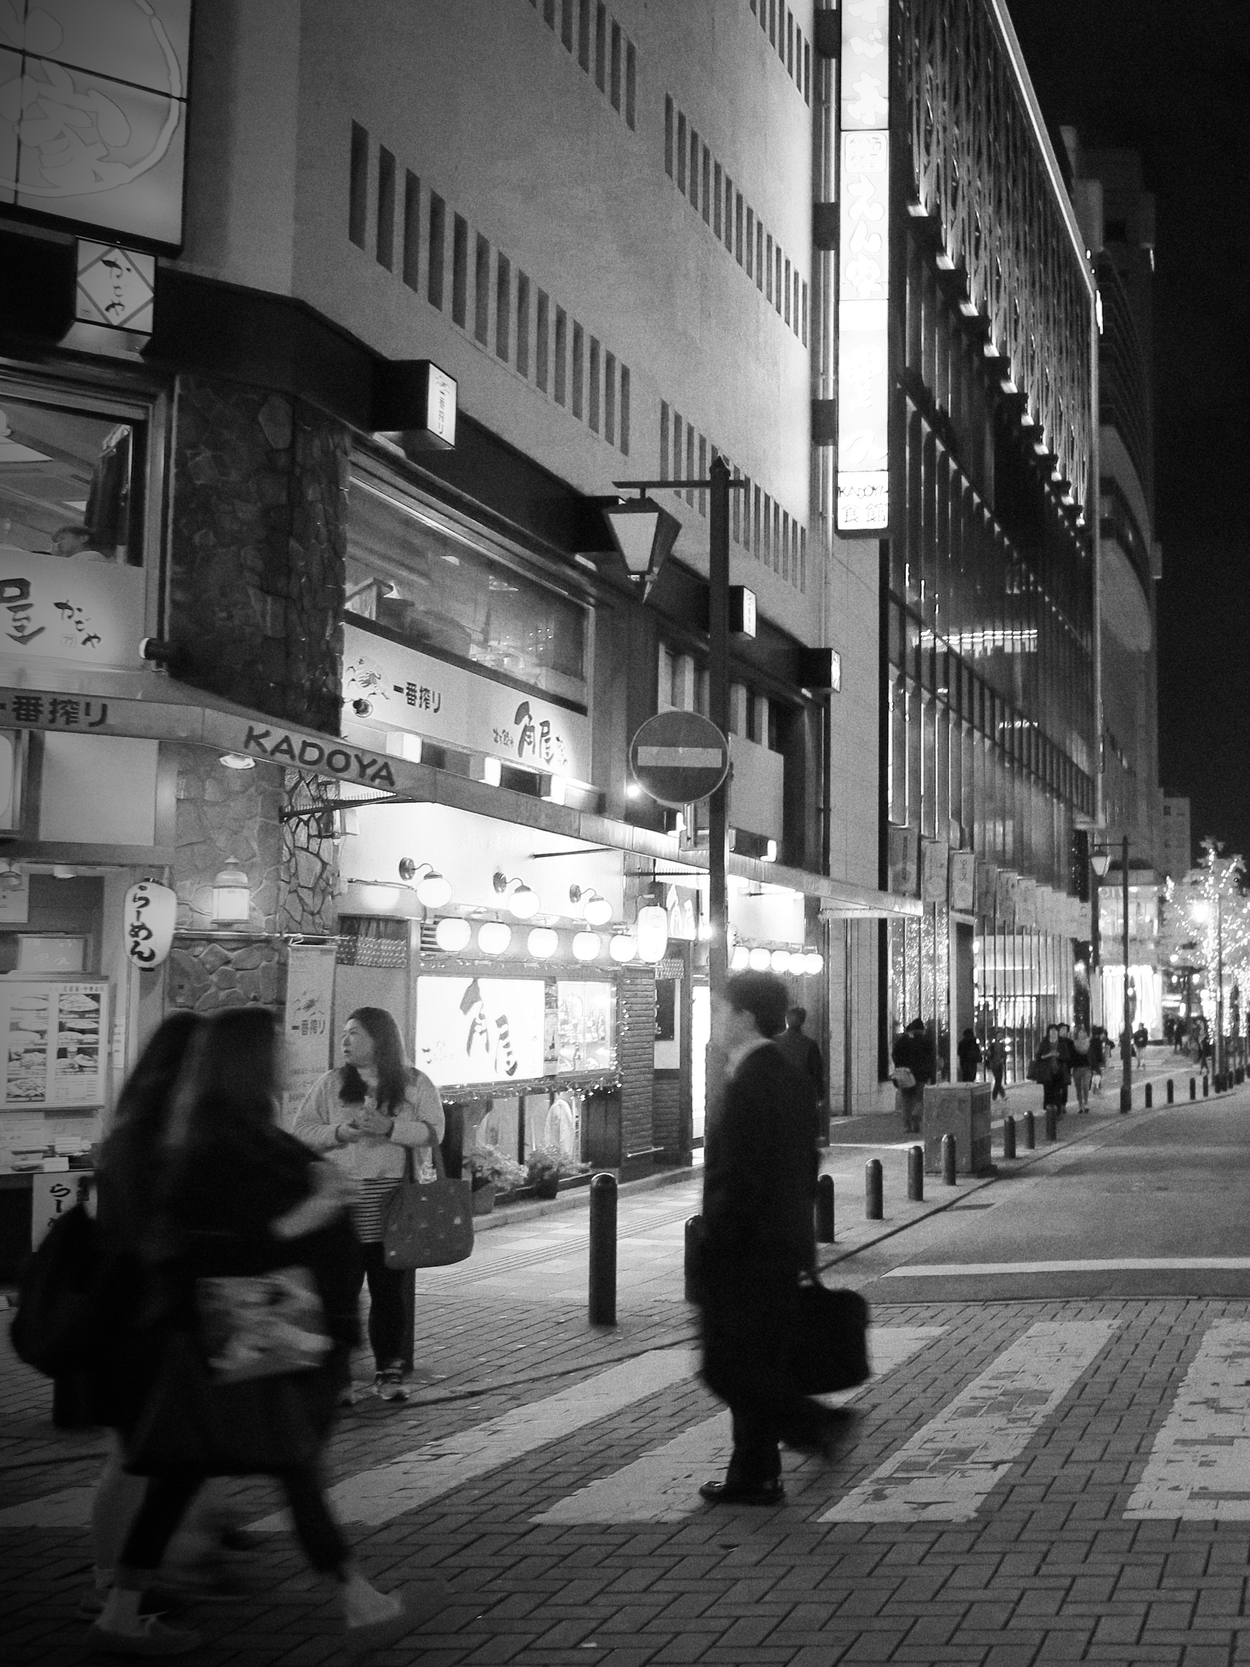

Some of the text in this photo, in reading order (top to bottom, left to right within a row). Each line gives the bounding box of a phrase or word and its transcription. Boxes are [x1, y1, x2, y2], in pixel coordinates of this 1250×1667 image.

[100, 257, 132, 318] かどや
[53, 599, 102, 649] かどや
[0, 695, 108, 728] 番搾り
[393, 681, 441, 714] 一番搾り
[244, 724, 395, 788] KADOYA
[128, 884, 156, 963] らーめん
